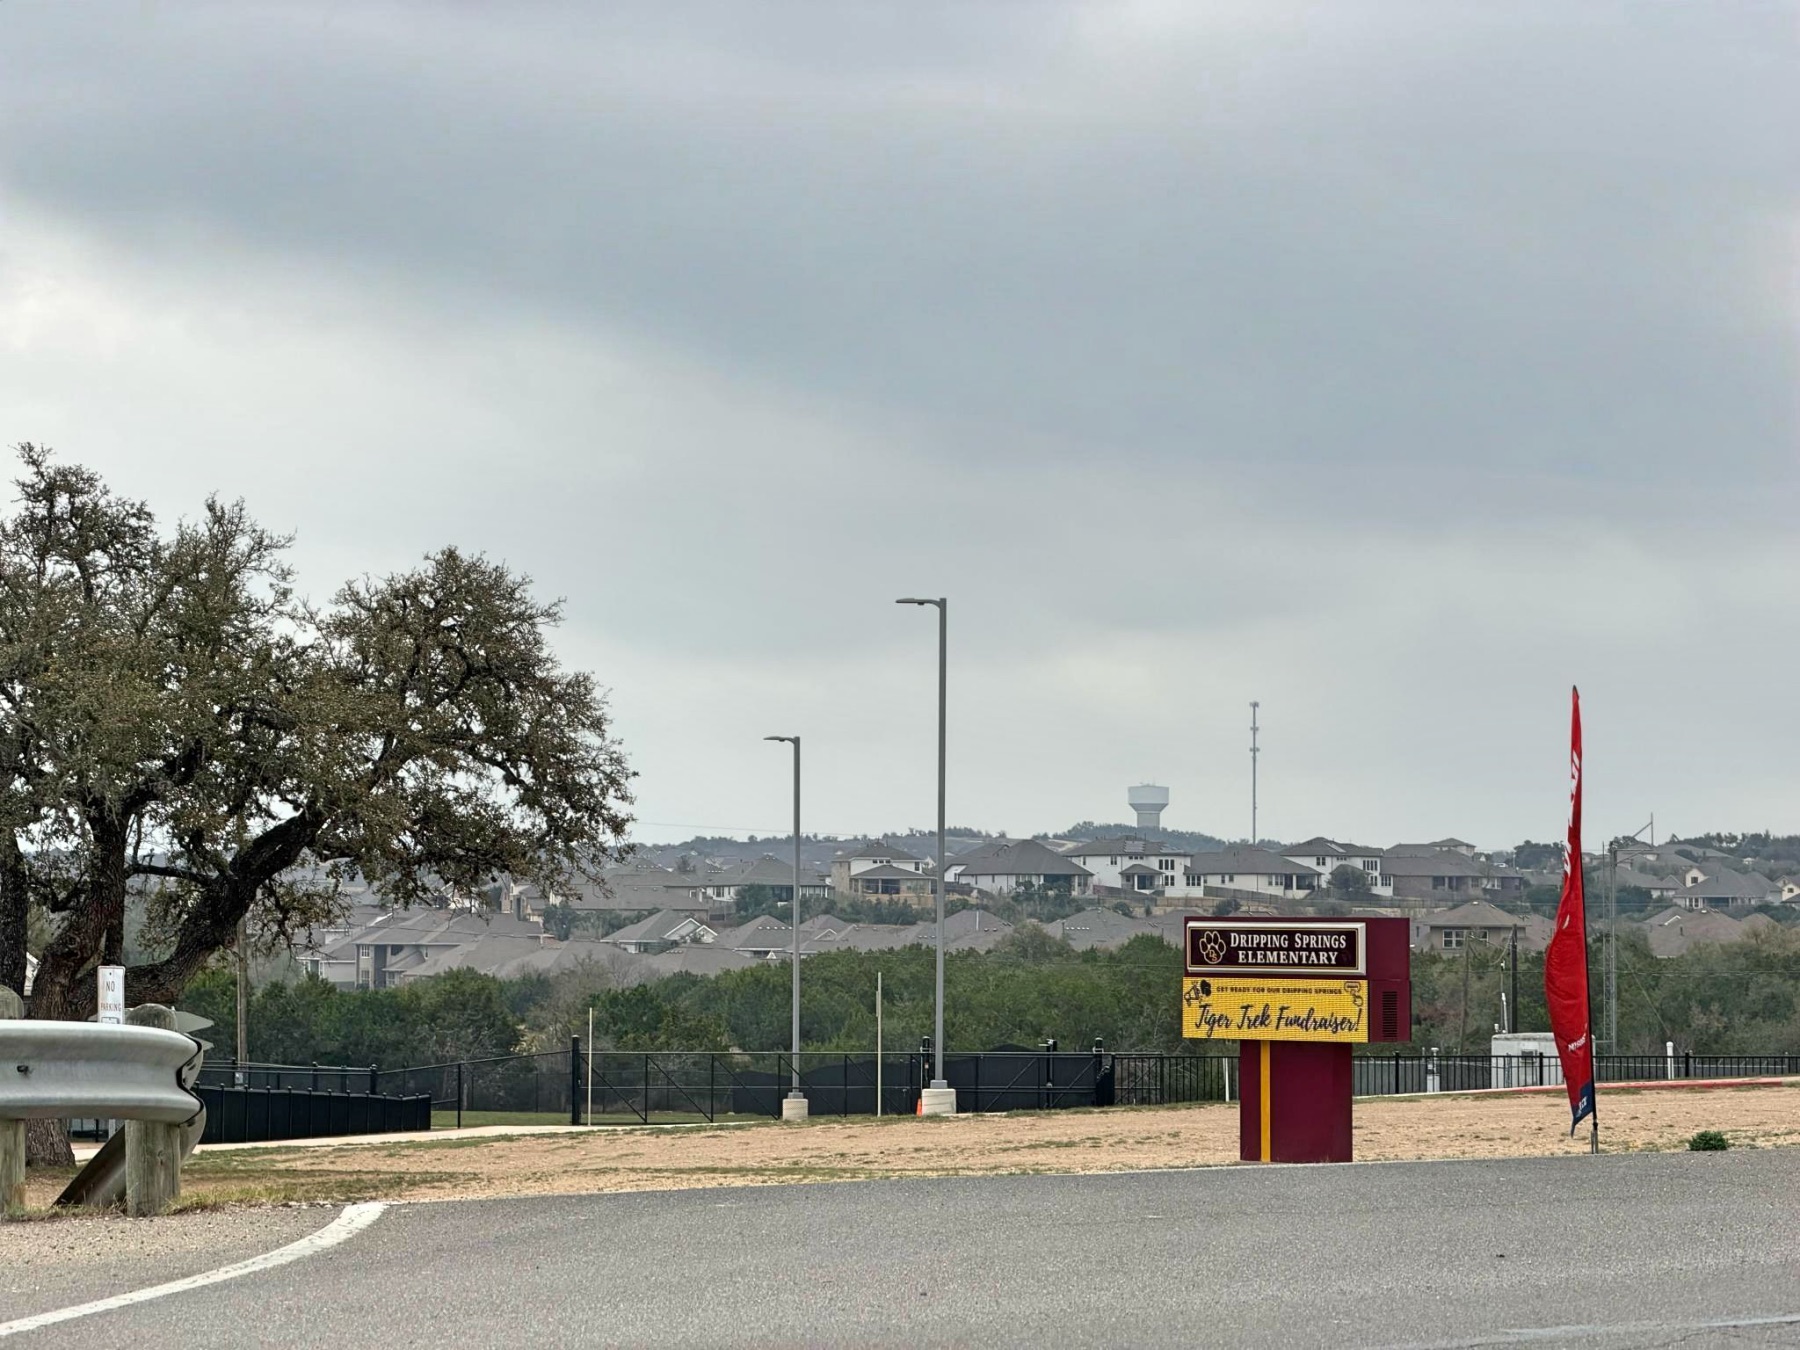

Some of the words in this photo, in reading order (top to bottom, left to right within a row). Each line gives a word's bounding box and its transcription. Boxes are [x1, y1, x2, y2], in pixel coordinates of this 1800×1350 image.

[1230, 932, 1289, 948] DRIPPING
[1294, 932, 1347, 949] SPRINGS
[1238, 950, 1338, 964] ELEMENTARY
[105, 980, 116, 992] NO
[100, 1002, 122, 1012] PARKING
[1195, 1004, 1233, 1037] Tiger
[1237, 1003, 1273, 1030] Trek
[1275, 1005, 1363, 1034] Fundraiser!
